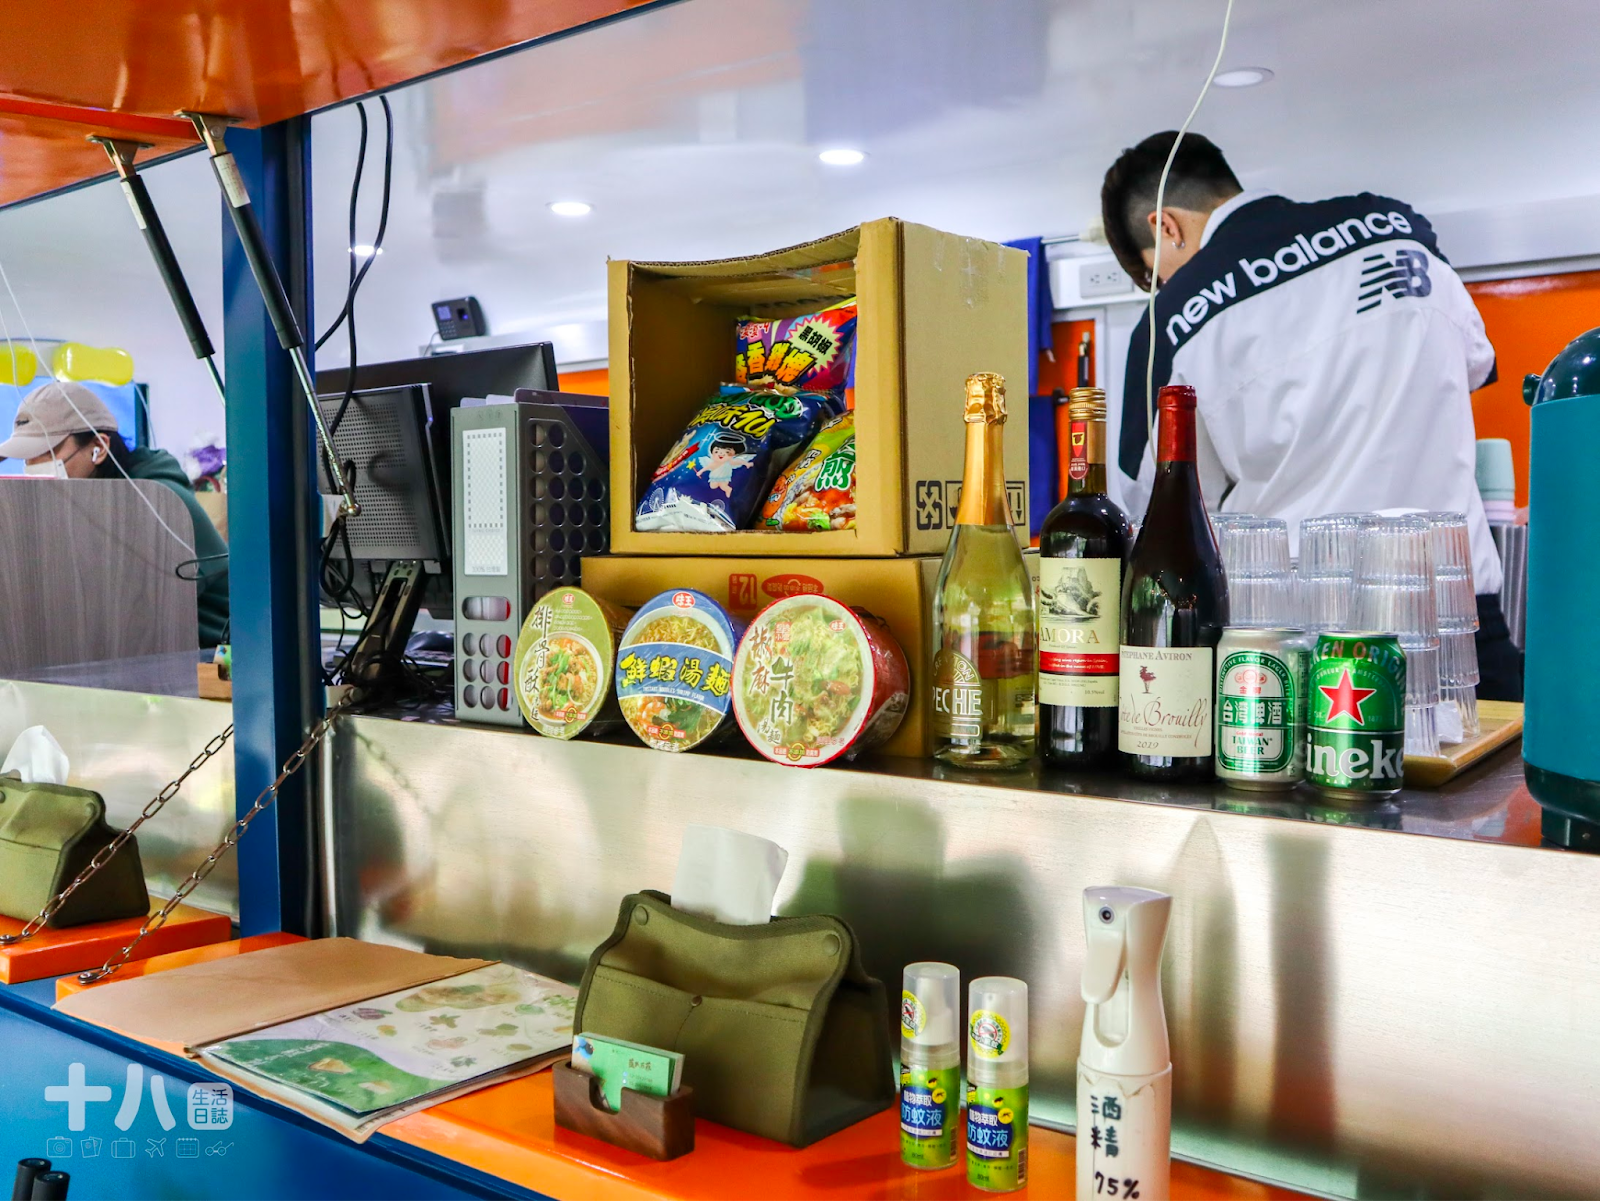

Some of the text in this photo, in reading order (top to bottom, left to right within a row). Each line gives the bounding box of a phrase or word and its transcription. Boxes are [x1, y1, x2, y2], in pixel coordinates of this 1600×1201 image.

[1165, 211, 1413, 346] new balance
[1155, 650, 1193, 661] AVIRON
[1238, 655, 1265, 664] FLAVOR
[1267, 660, 1286, 677] LAGER
[619, 652, 731, 698] 鮮蝦湯麵
[769, 656, 795, 726] 牛肉
[1143, 696, 1208, 748] Brouilly
[1237, 746, 1265, 755] BEER
[901, 1103, 943, 1127] 防蚊液
[1090, 1095, 1122, 1158] 酒精
[967, 1126, 1009, 1148] 防蚊液
[1094, 1171, 1140, 1200] 75%
